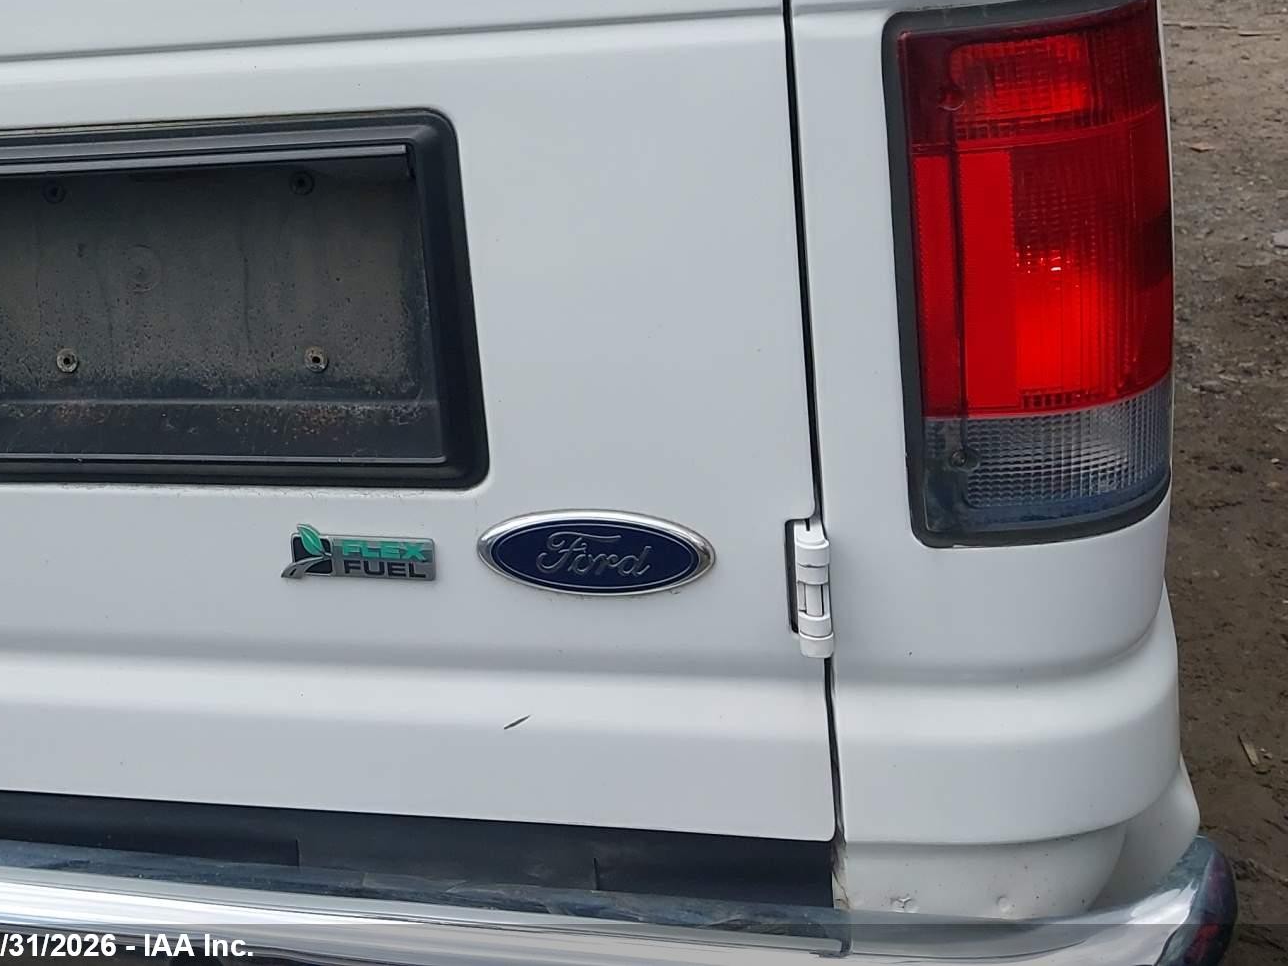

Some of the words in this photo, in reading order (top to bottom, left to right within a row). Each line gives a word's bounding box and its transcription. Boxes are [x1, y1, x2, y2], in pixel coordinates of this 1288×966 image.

[341, 539, 428, 562] FLEX
[534, 530, 652, 578] Ford
[343, 560, 427, 579] FUEL
